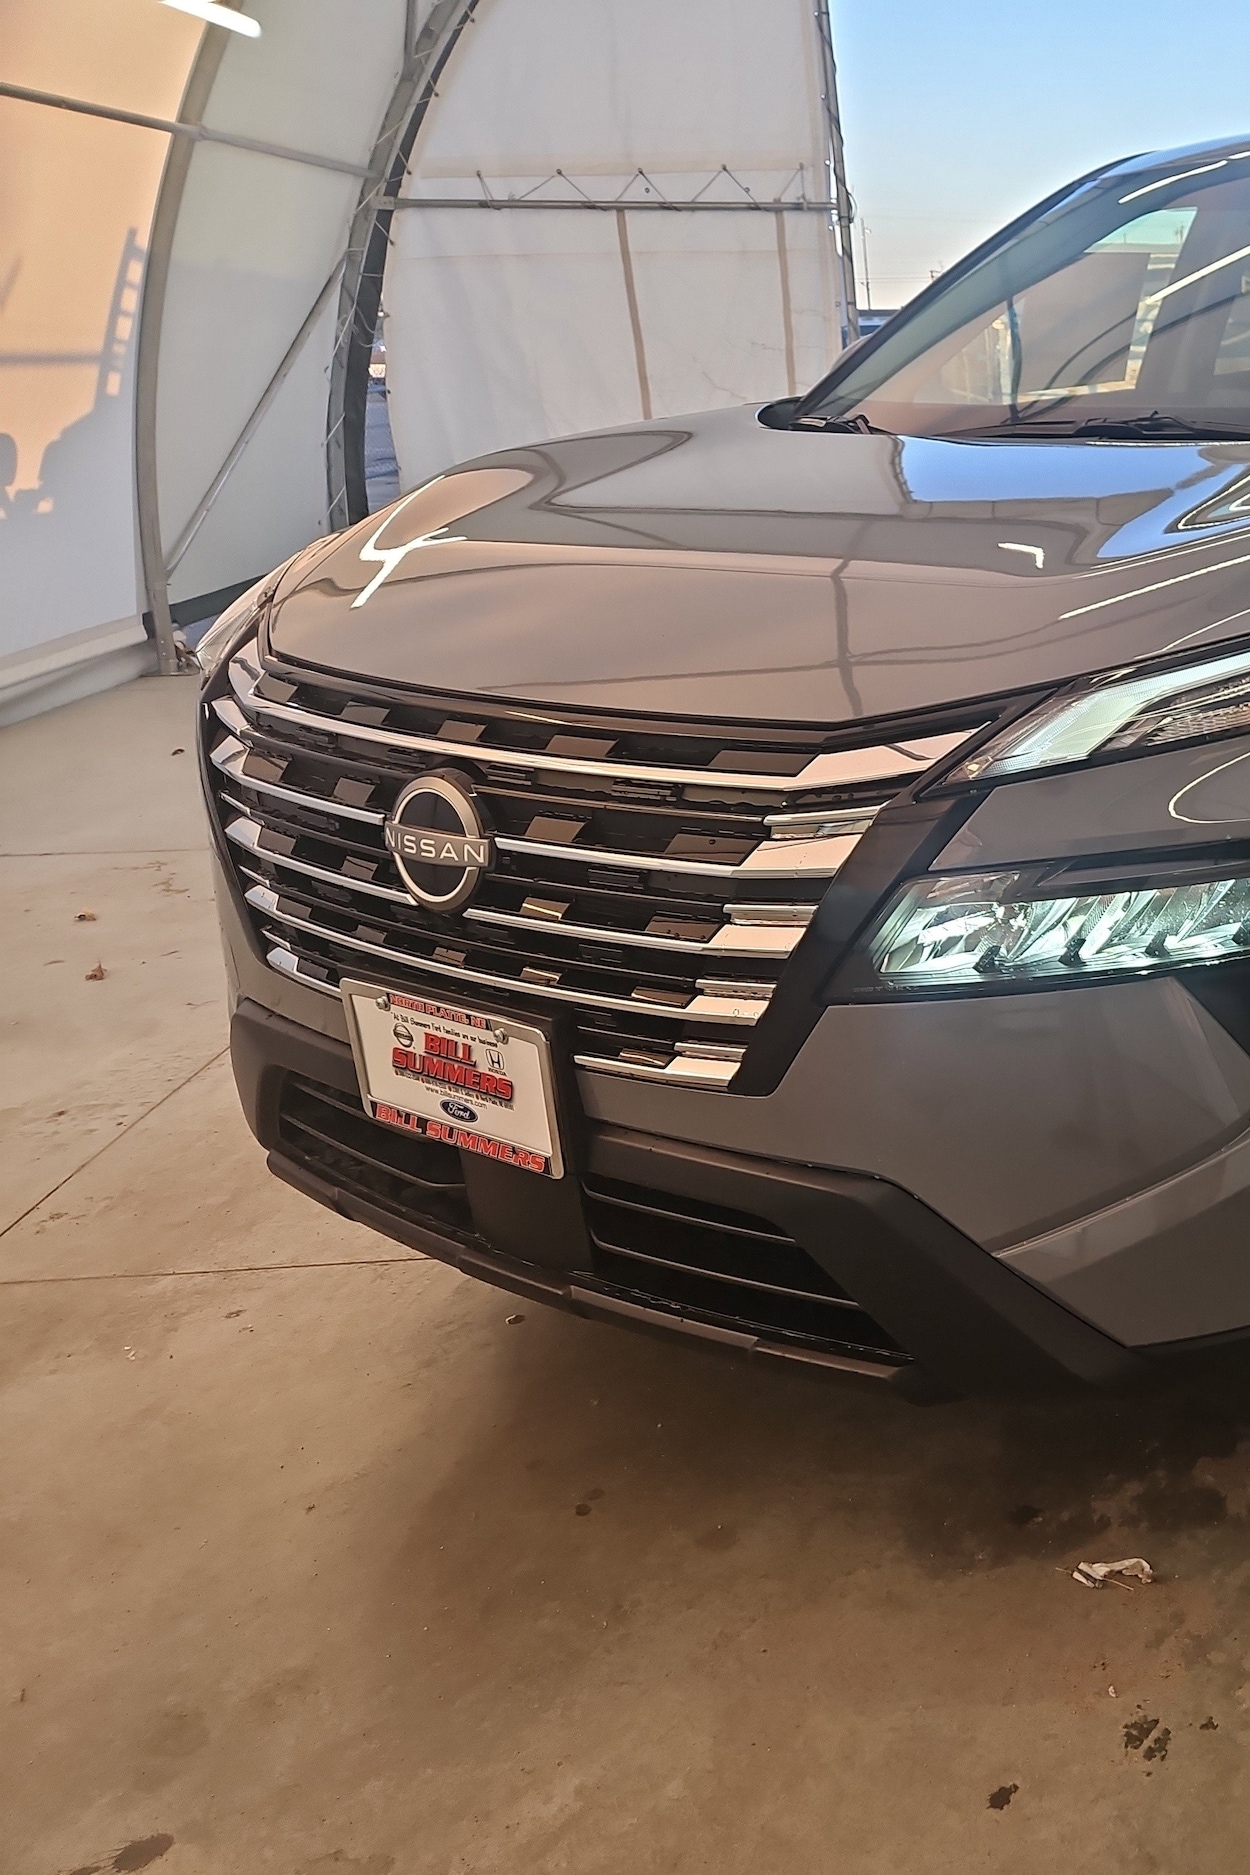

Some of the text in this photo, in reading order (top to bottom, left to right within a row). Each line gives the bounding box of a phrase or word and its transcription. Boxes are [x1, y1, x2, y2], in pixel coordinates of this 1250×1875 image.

[385, 826, 485, 863] NISSAN
[390, 994, 425, 1012] NORTH
[470, 1015, 486, 1029] NE
[400, 1014, 410, 1024] Bill
[410, 1017, 431, 1030] Summers
[424, 1032, 477, 1066] BILL
[392, 1047, 513, 1101] SUMMERS
[447, 1101, 471, 1120] Ford
[375, 1103, 546, 1173] BILL SUMMERS
